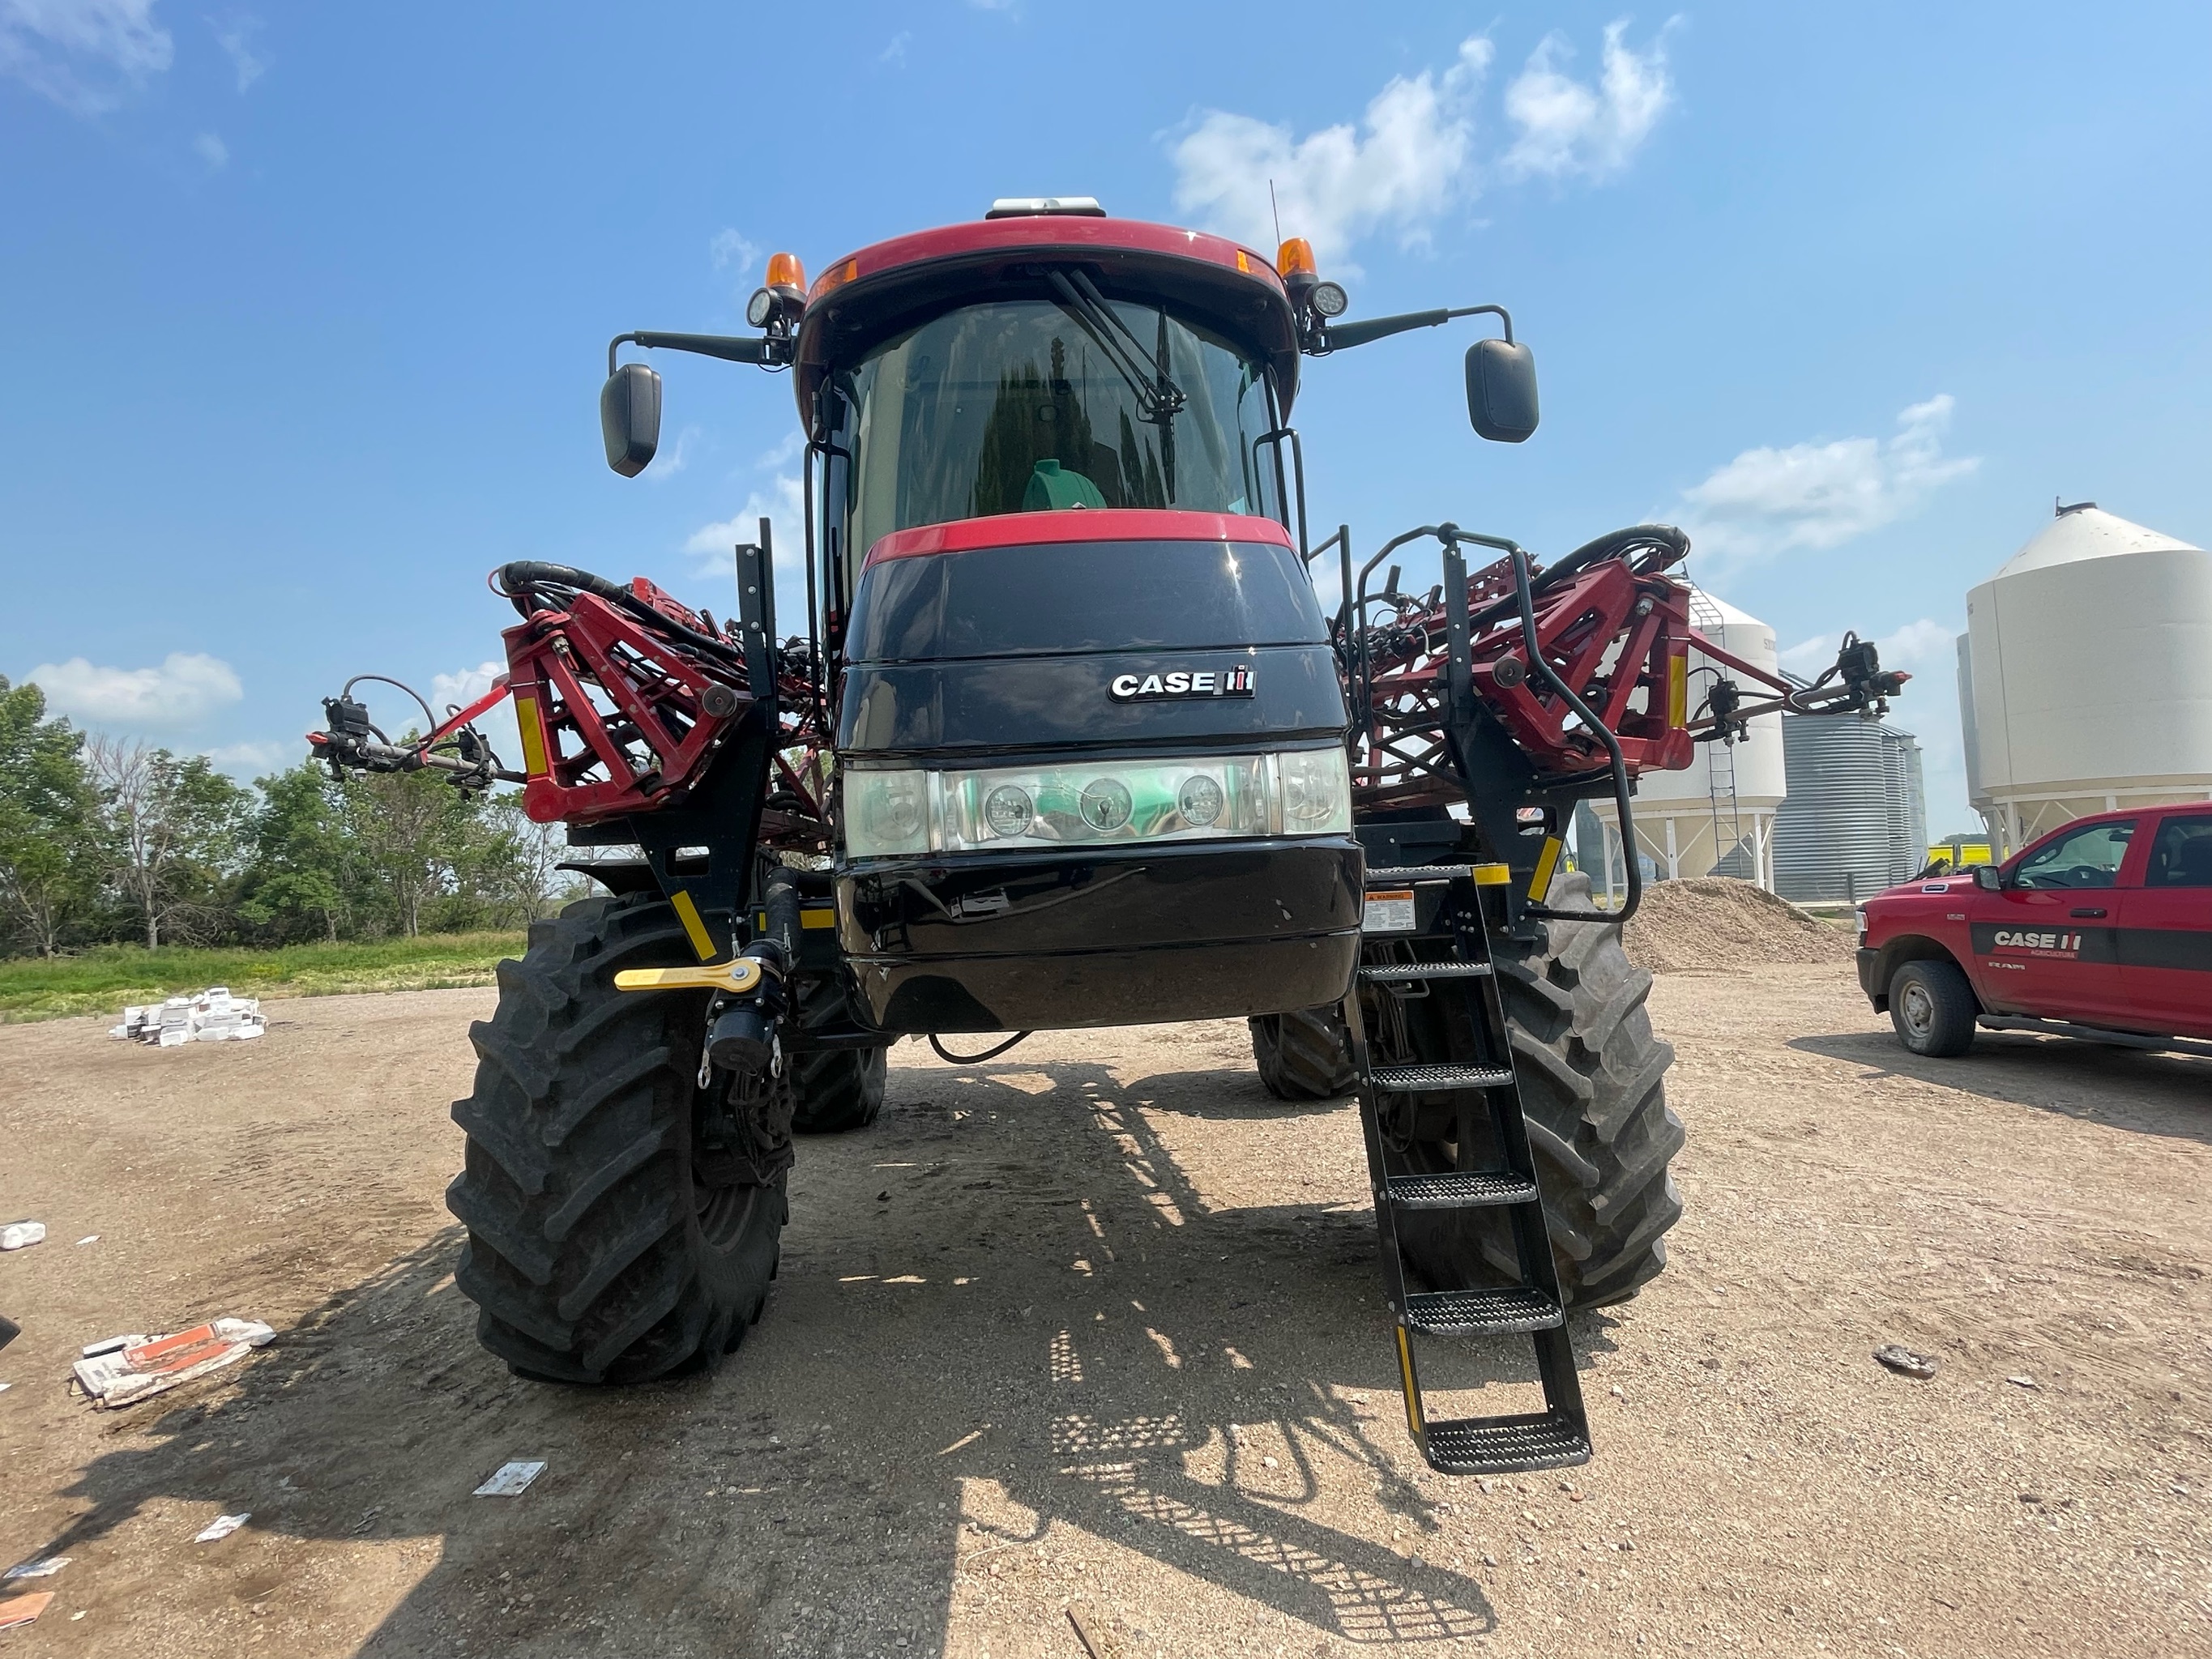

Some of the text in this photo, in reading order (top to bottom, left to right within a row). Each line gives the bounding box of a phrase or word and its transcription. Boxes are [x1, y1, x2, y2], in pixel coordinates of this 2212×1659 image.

[1112, 672, 1215, 697] CASE
[1994, 931, 2056, 949] CASE
[1988, 962, 2026, 970] RAM
